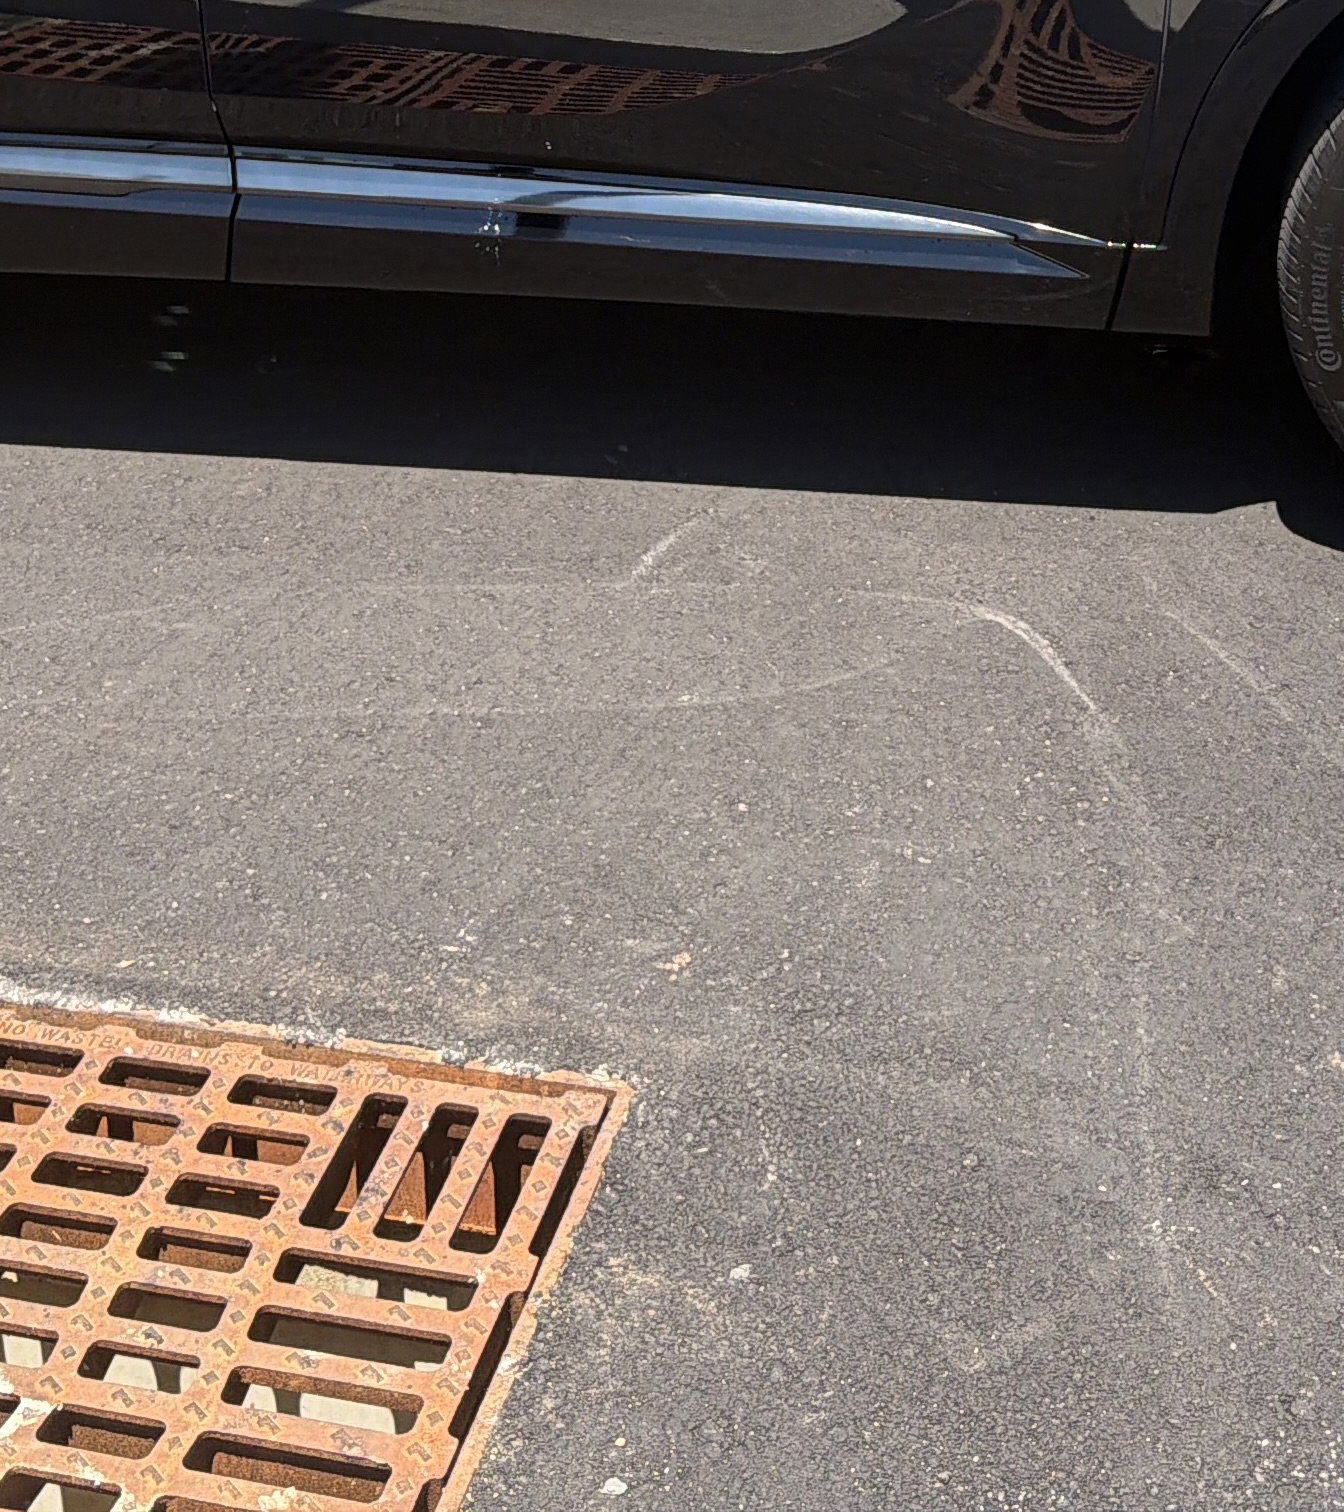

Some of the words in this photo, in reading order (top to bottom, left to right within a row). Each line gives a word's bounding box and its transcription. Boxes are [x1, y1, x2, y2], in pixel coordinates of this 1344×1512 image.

[1308, 241, 1342, 372] Continental
[147, 1044, 230, 1066] DRAINS
[246, 1055, 274, 1072] TO
